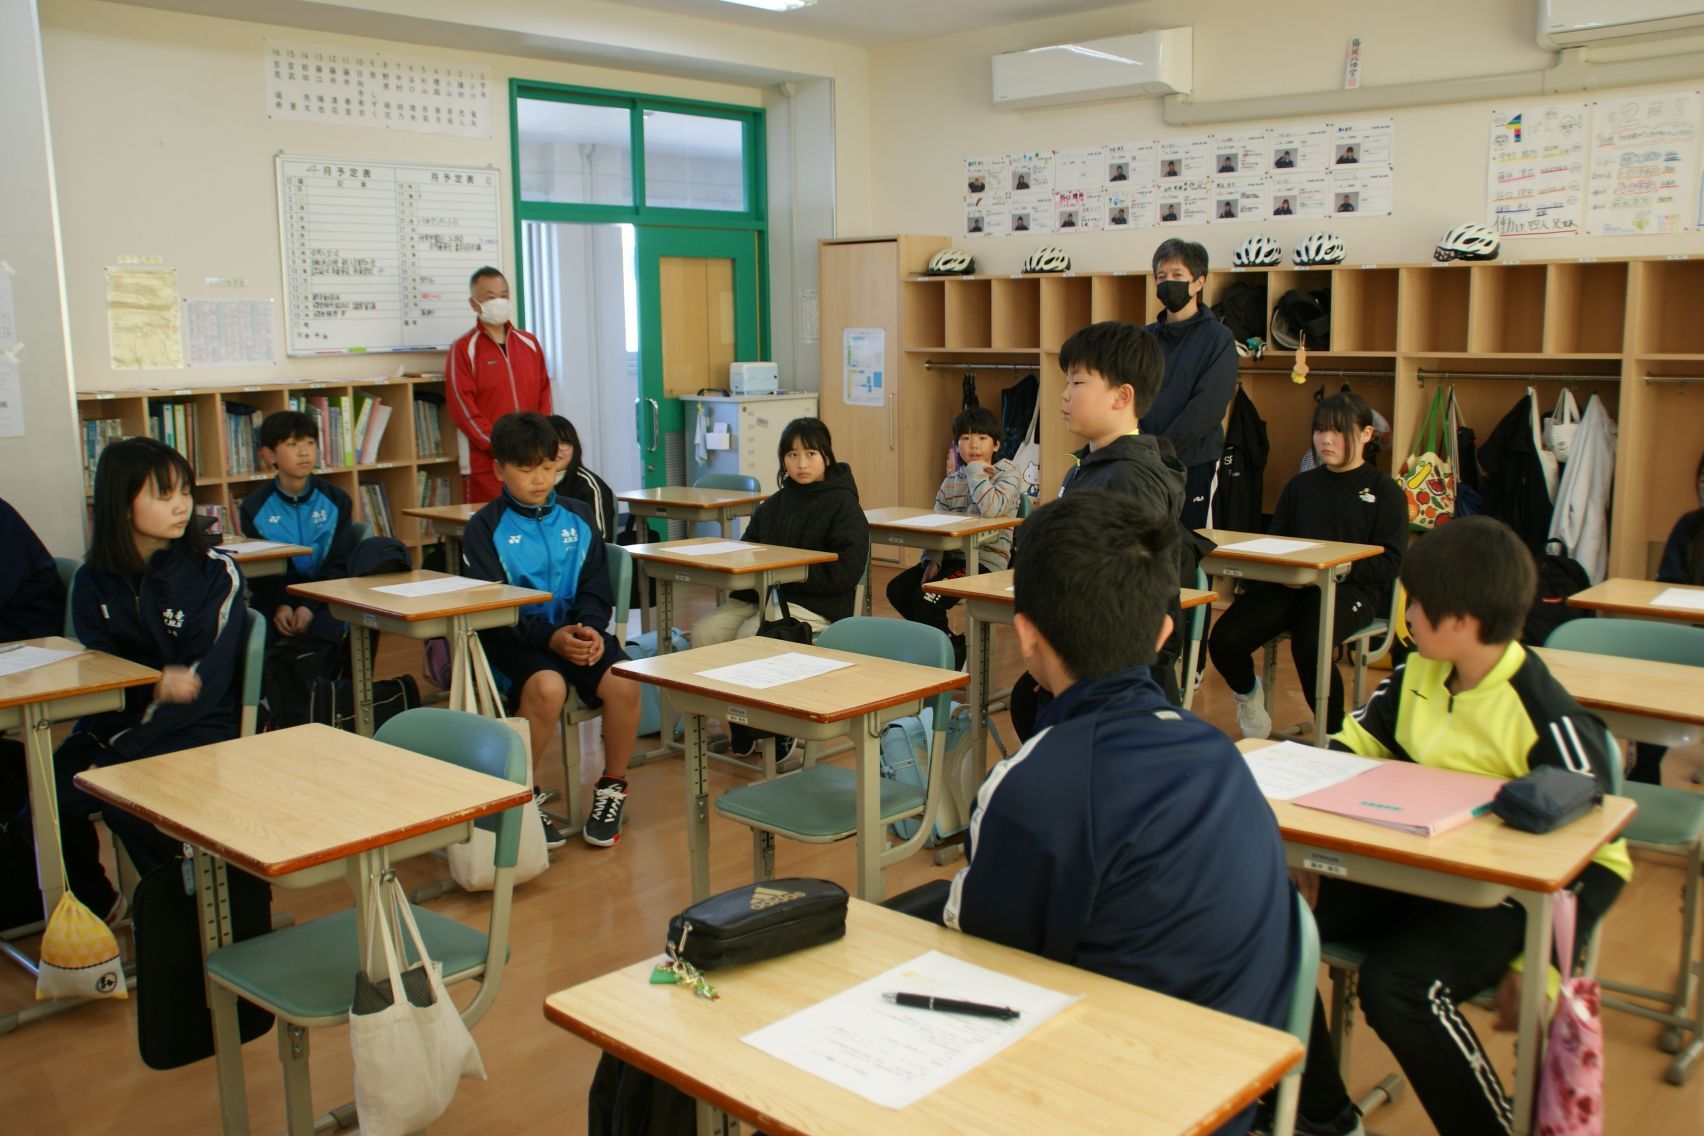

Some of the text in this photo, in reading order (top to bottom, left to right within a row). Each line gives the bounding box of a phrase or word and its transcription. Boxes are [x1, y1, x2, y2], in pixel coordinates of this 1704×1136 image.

[431, 172, 475, 184] 月予定表
[750, 891, 807, 911] adidas
